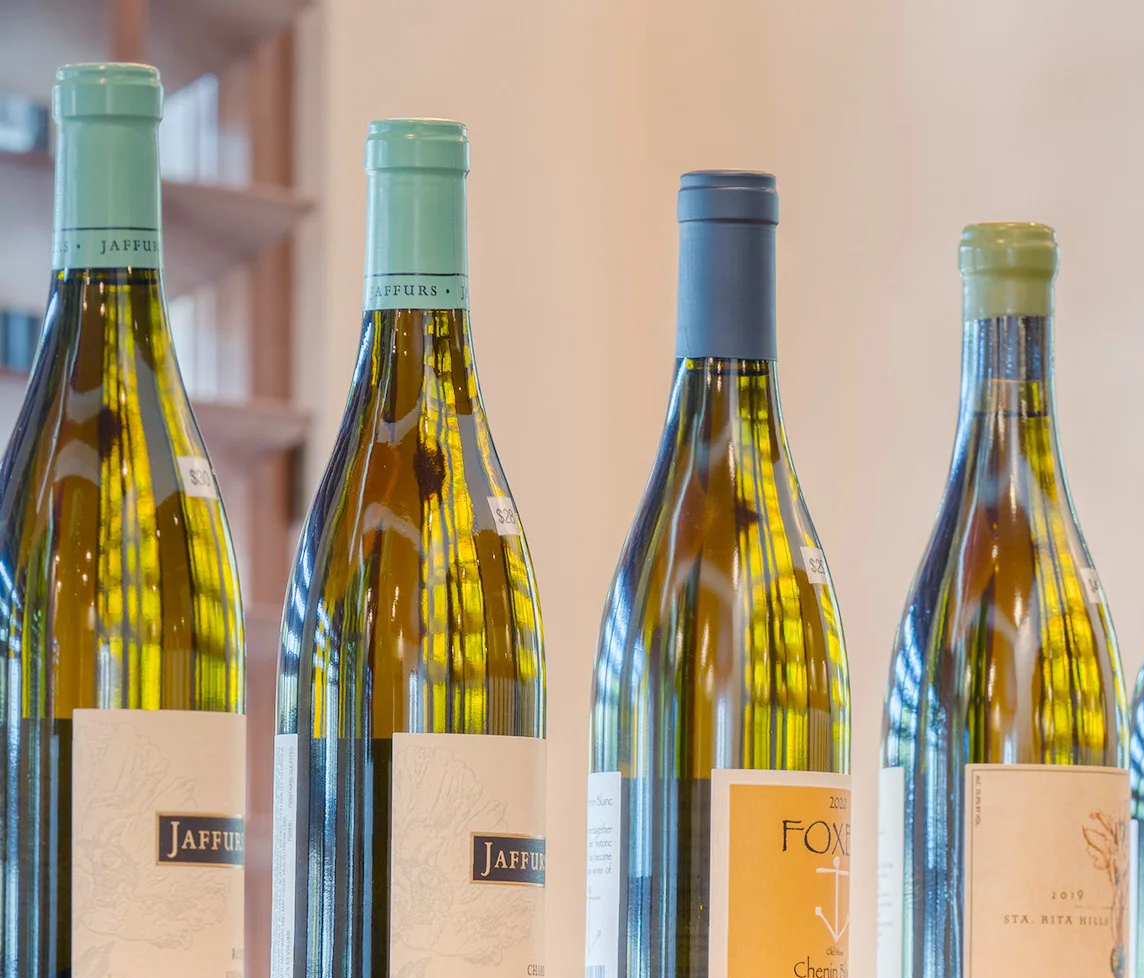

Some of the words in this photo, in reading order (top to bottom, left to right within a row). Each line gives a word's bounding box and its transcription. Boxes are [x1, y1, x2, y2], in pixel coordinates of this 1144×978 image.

[495, 507, 516, 524] $28
[1050, 889, 1084, 902] 2019
[1003, 914, 1035, 925] STA.
[1041, 915, 1073, 925] RITA
[1079, 916, 1109, 927] HILLS
